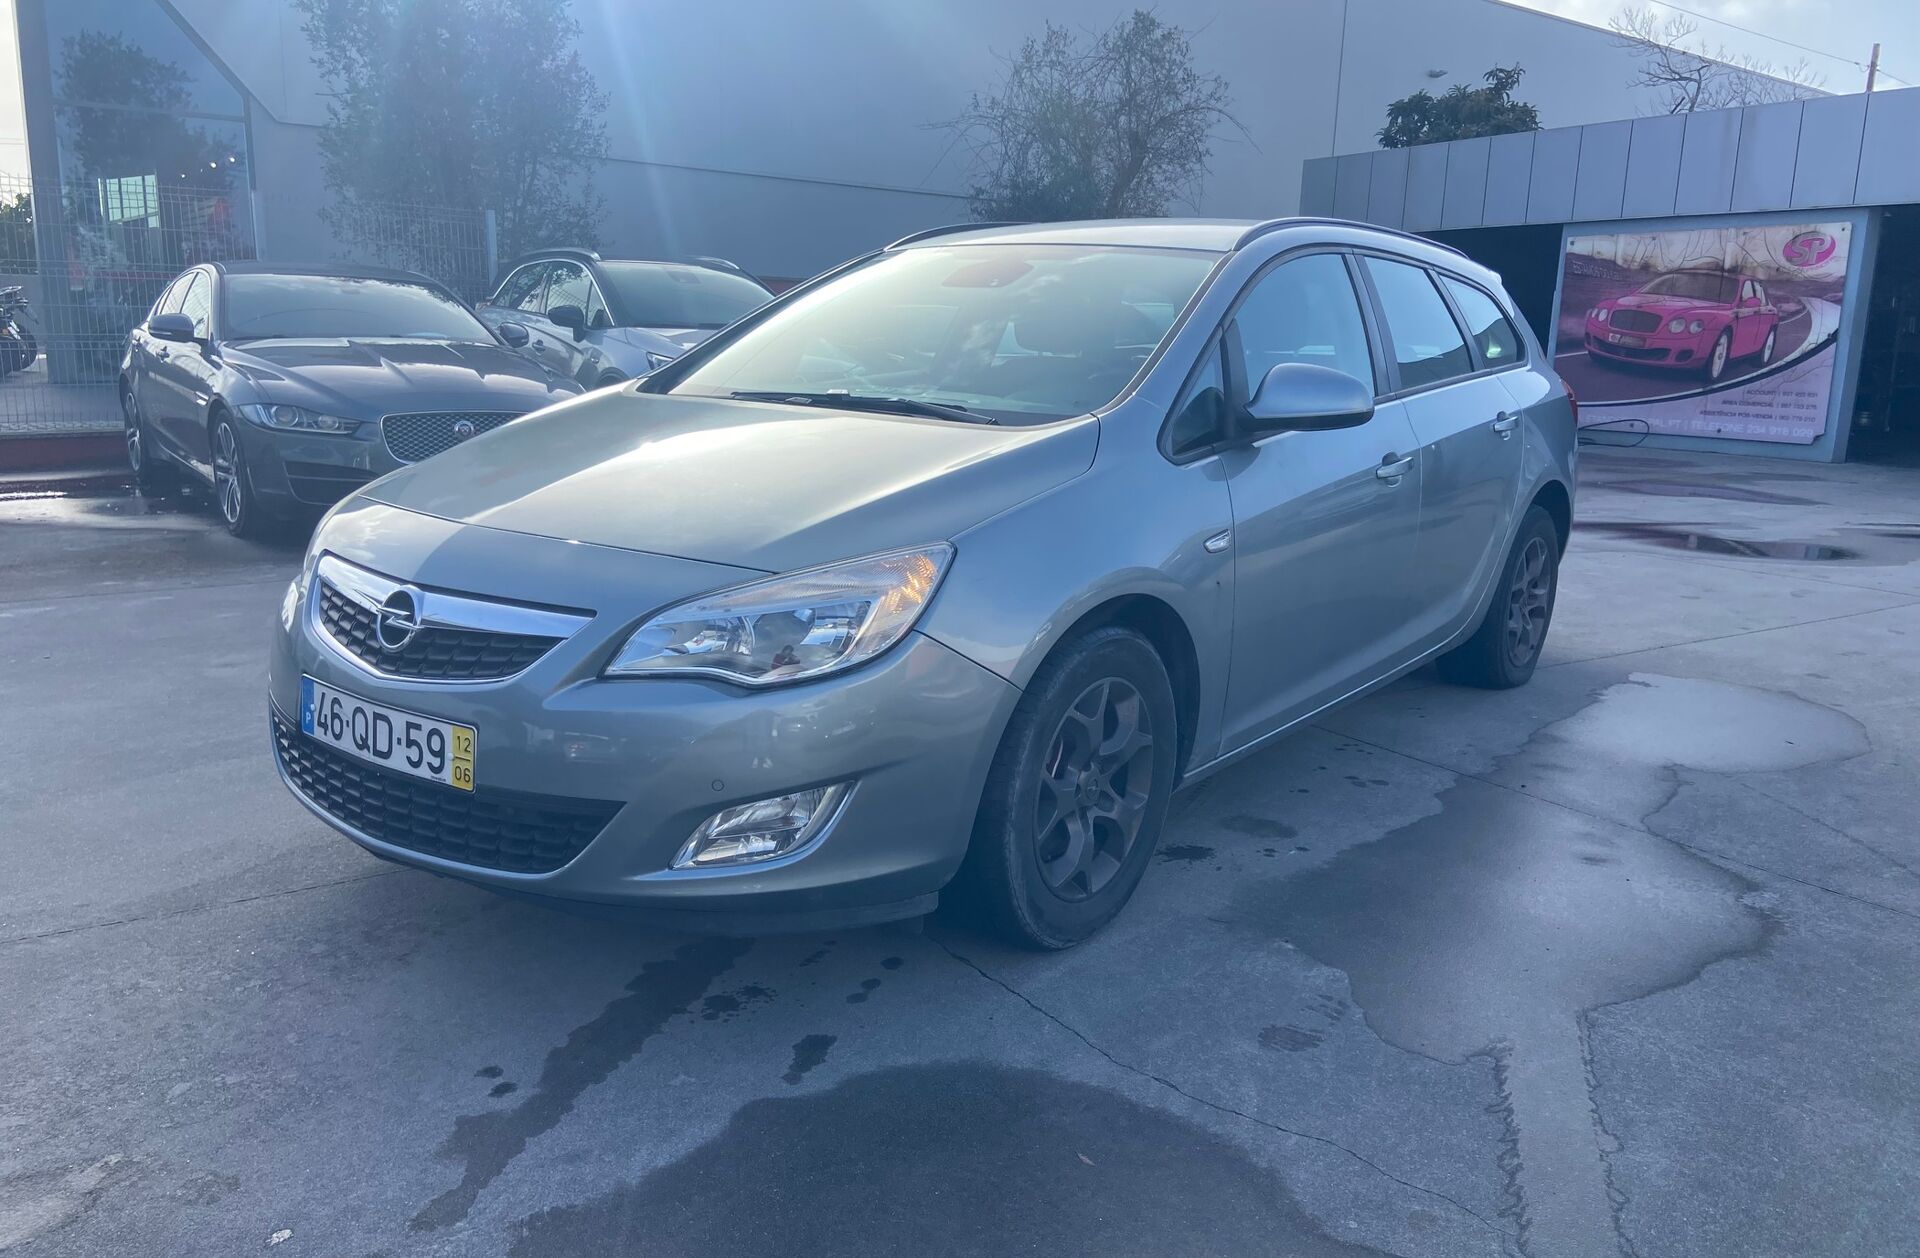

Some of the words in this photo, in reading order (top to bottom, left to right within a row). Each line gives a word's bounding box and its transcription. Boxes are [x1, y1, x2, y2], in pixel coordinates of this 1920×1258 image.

[1786, 231, 1831, 266] SP
[1691, 420, 1745, 433] TELEFONE
[456, 735, 472, 754] 12
[454, 765, 471, 784] 06
